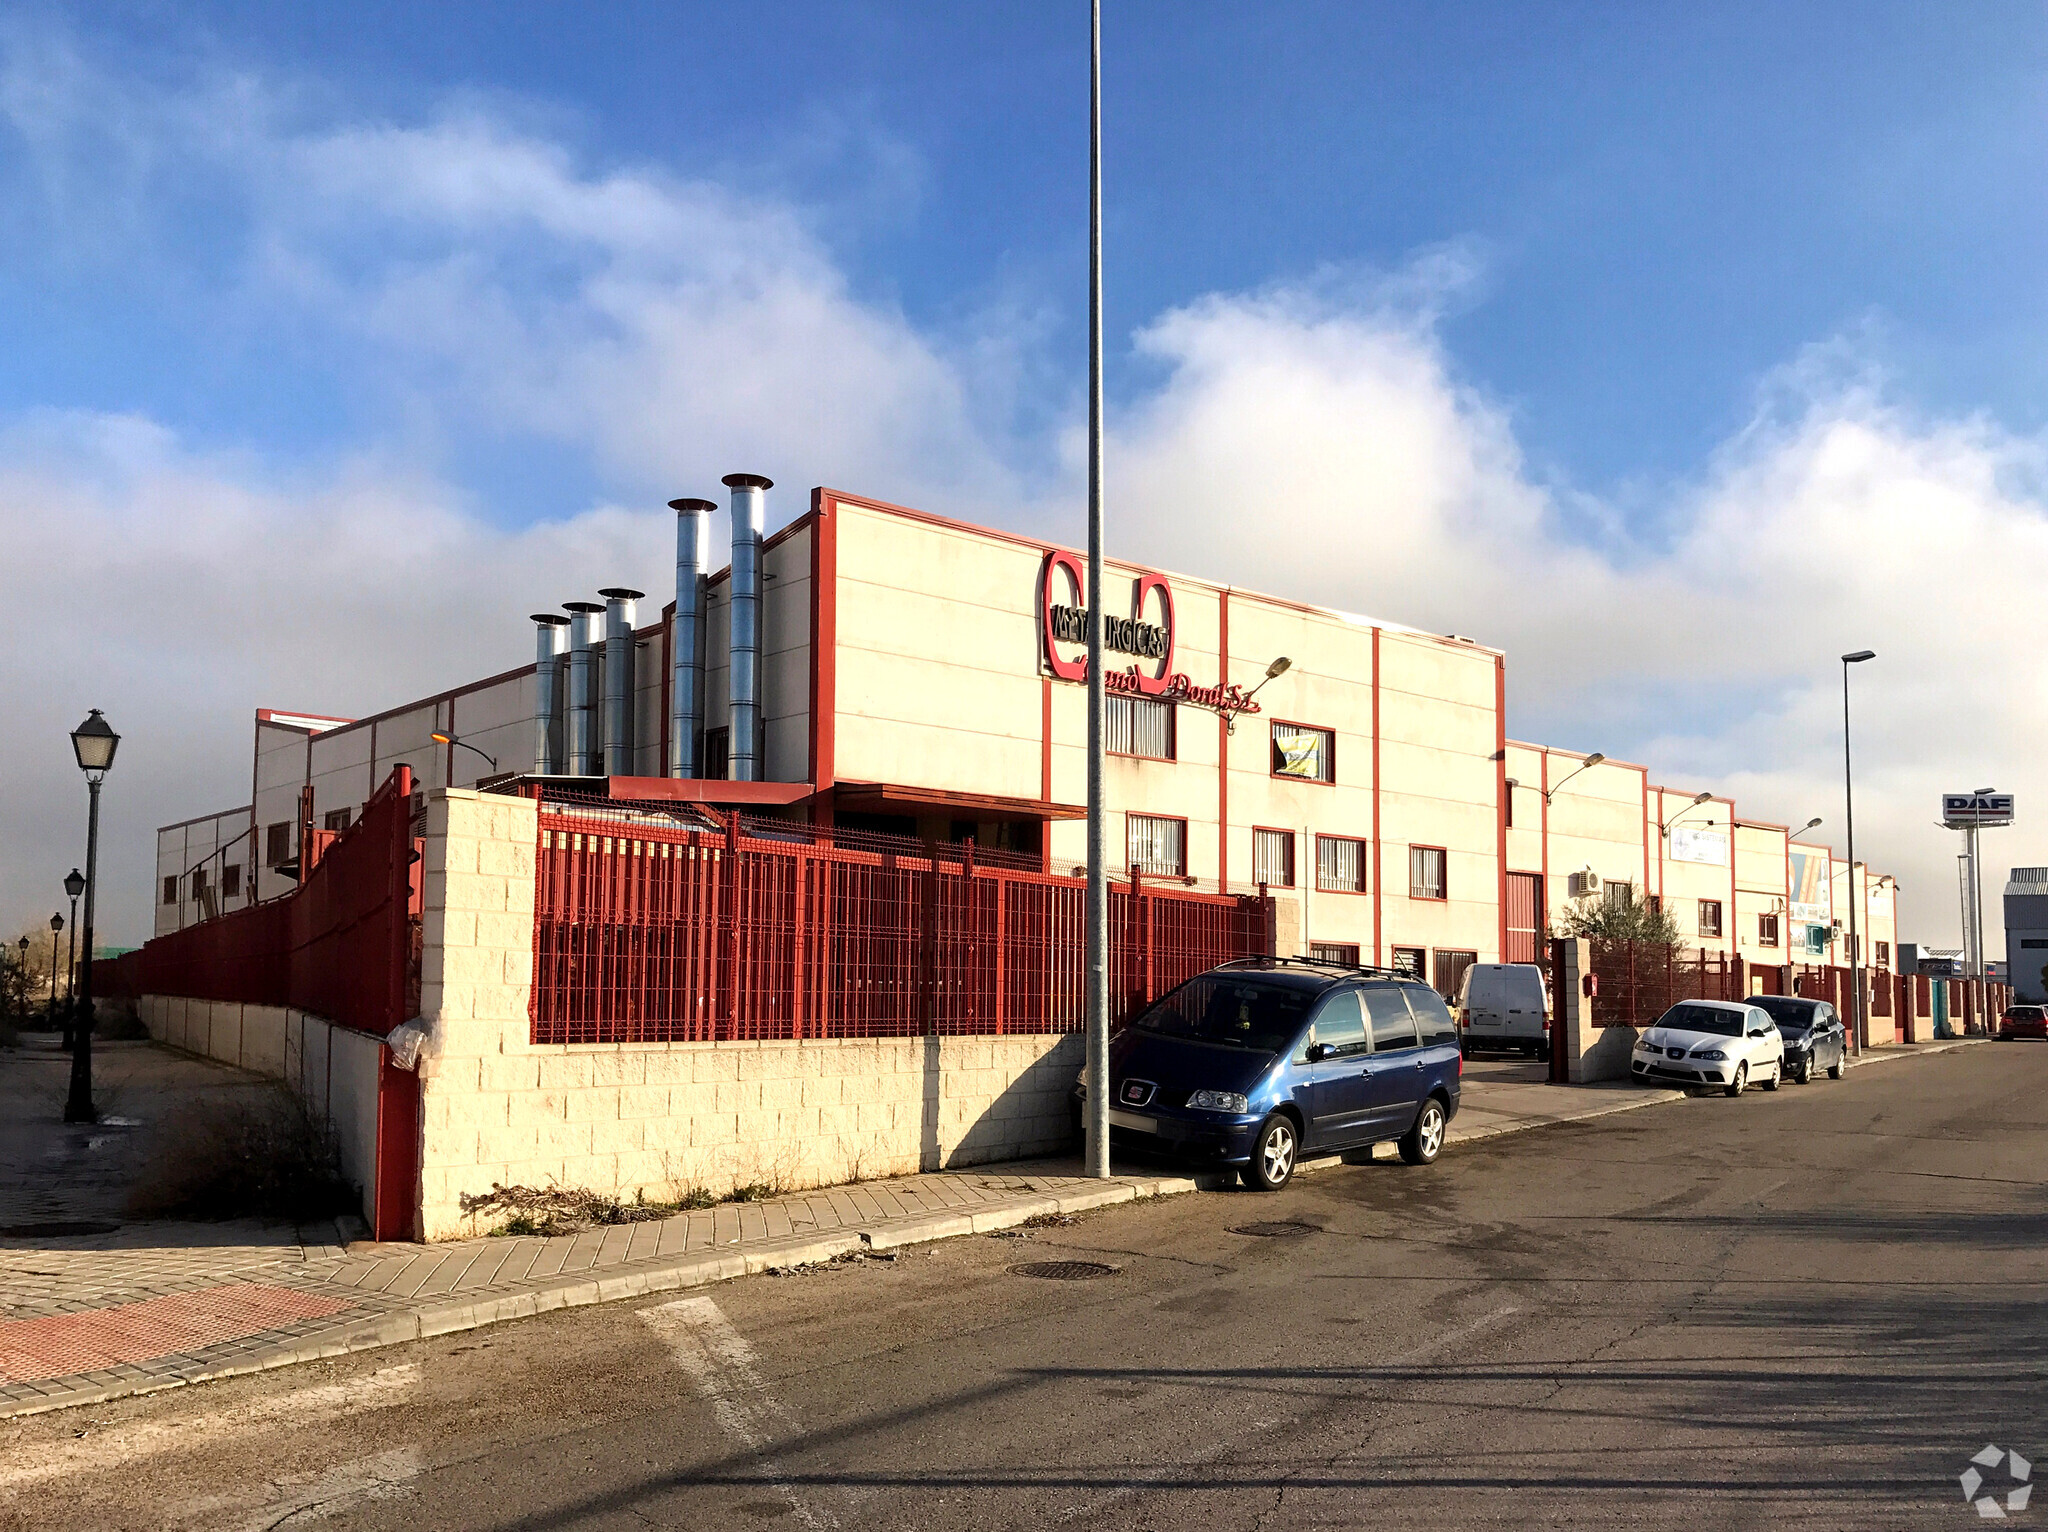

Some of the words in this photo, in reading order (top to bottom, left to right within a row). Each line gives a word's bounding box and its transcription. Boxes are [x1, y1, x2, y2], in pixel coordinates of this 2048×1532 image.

[1051, 604, 1166, 658] METURGICAS
[1084, 660, 1138, 691] ano
[1947, 798, 2010, 809] DAF
